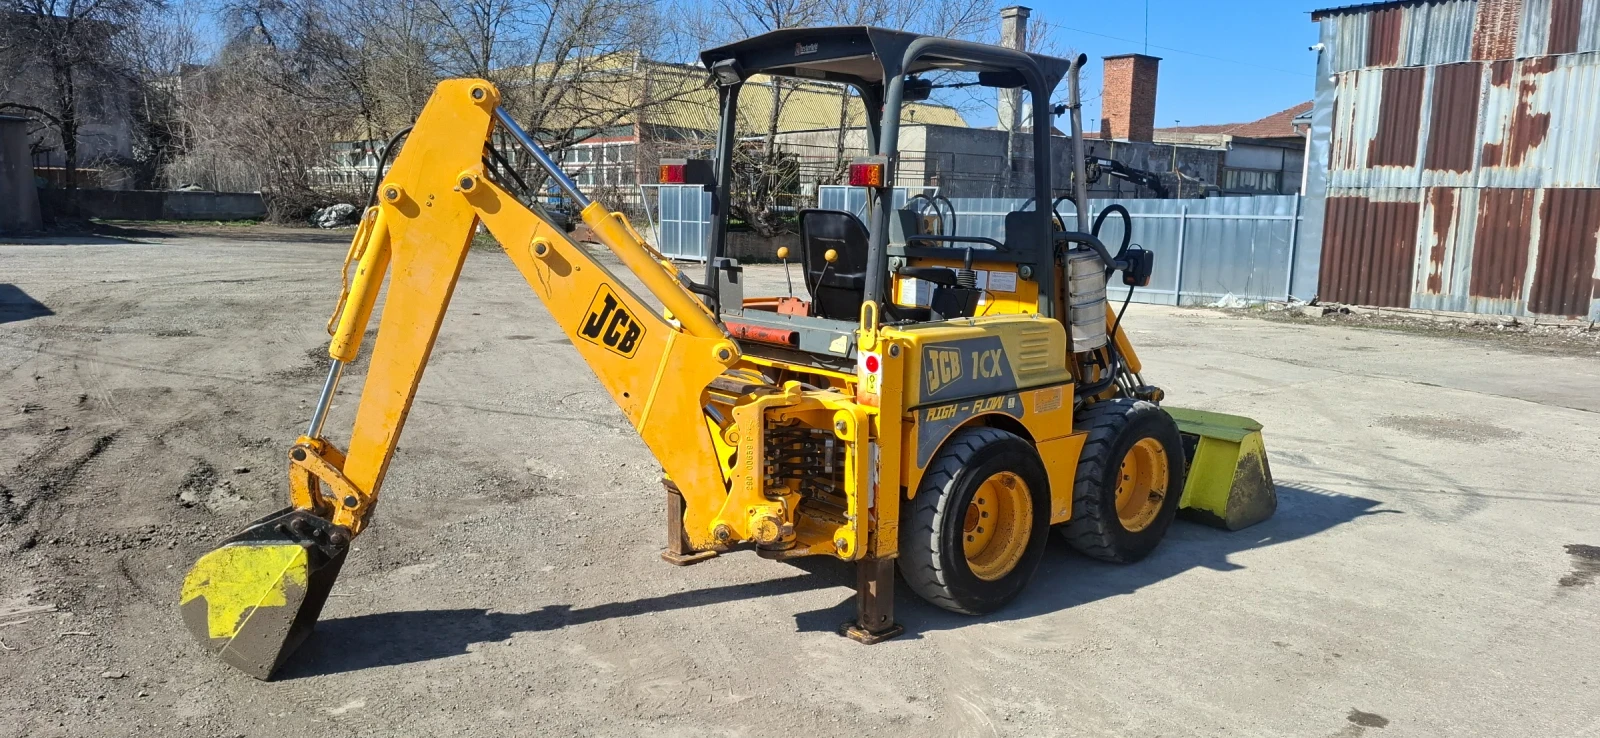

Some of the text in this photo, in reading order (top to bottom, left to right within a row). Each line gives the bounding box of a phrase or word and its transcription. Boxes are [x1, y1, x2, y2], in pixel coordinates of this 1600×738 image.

[581, 292, 642, 354] JCB
[928, 348, 1003, 392] JCB 1CX
[926, 403, 958, 422] HIGH
[972, 395, 1006, 414] FLOW
